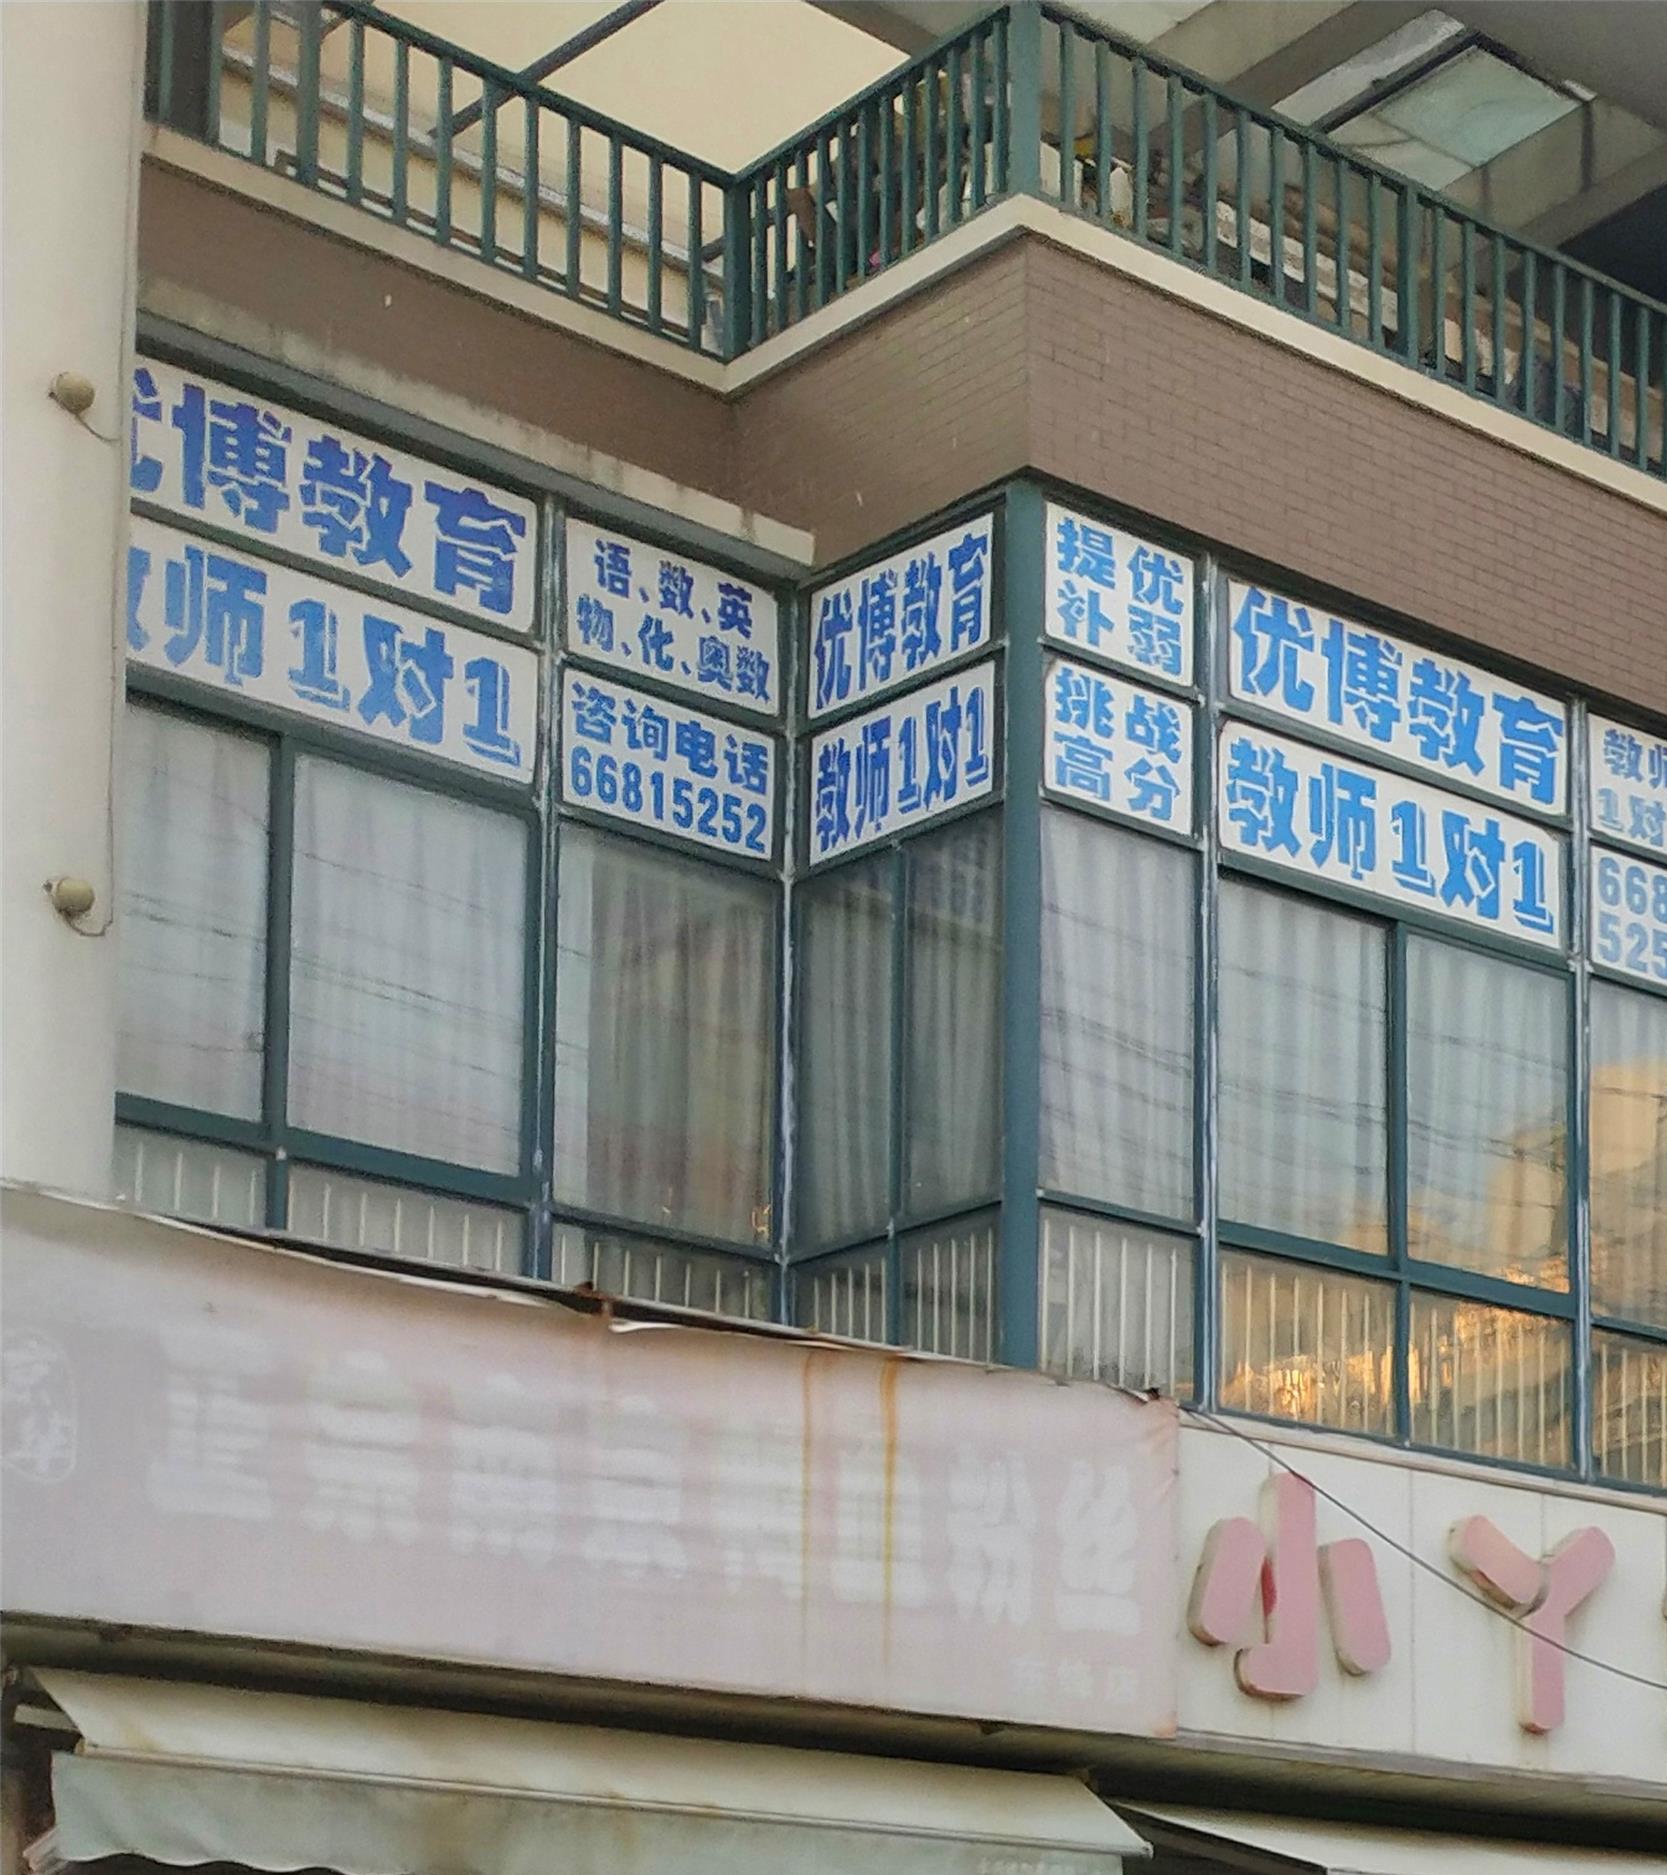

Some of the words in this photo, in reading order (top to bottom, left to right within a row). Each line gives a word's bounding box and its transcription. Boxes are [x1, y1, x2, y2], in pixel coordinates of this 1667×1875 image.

[813, 531, 989, 708] 优博教育
[1056, 516, 1185, 615] 提优
[1056, 580, 1183, 676] 补弱
[570, 682, 769, 796] 咨询电话
[1054, 666, 1183, 763] 挑战
[1232, 586, 1565, 806] 优博教育
[570, 749, 766, 855] 66815252
[814, 685, 987, 851] 教师1对1
[1055, 732, 1179, 822] 高分
[1226, 738, 1555, 935] 教师1对1
